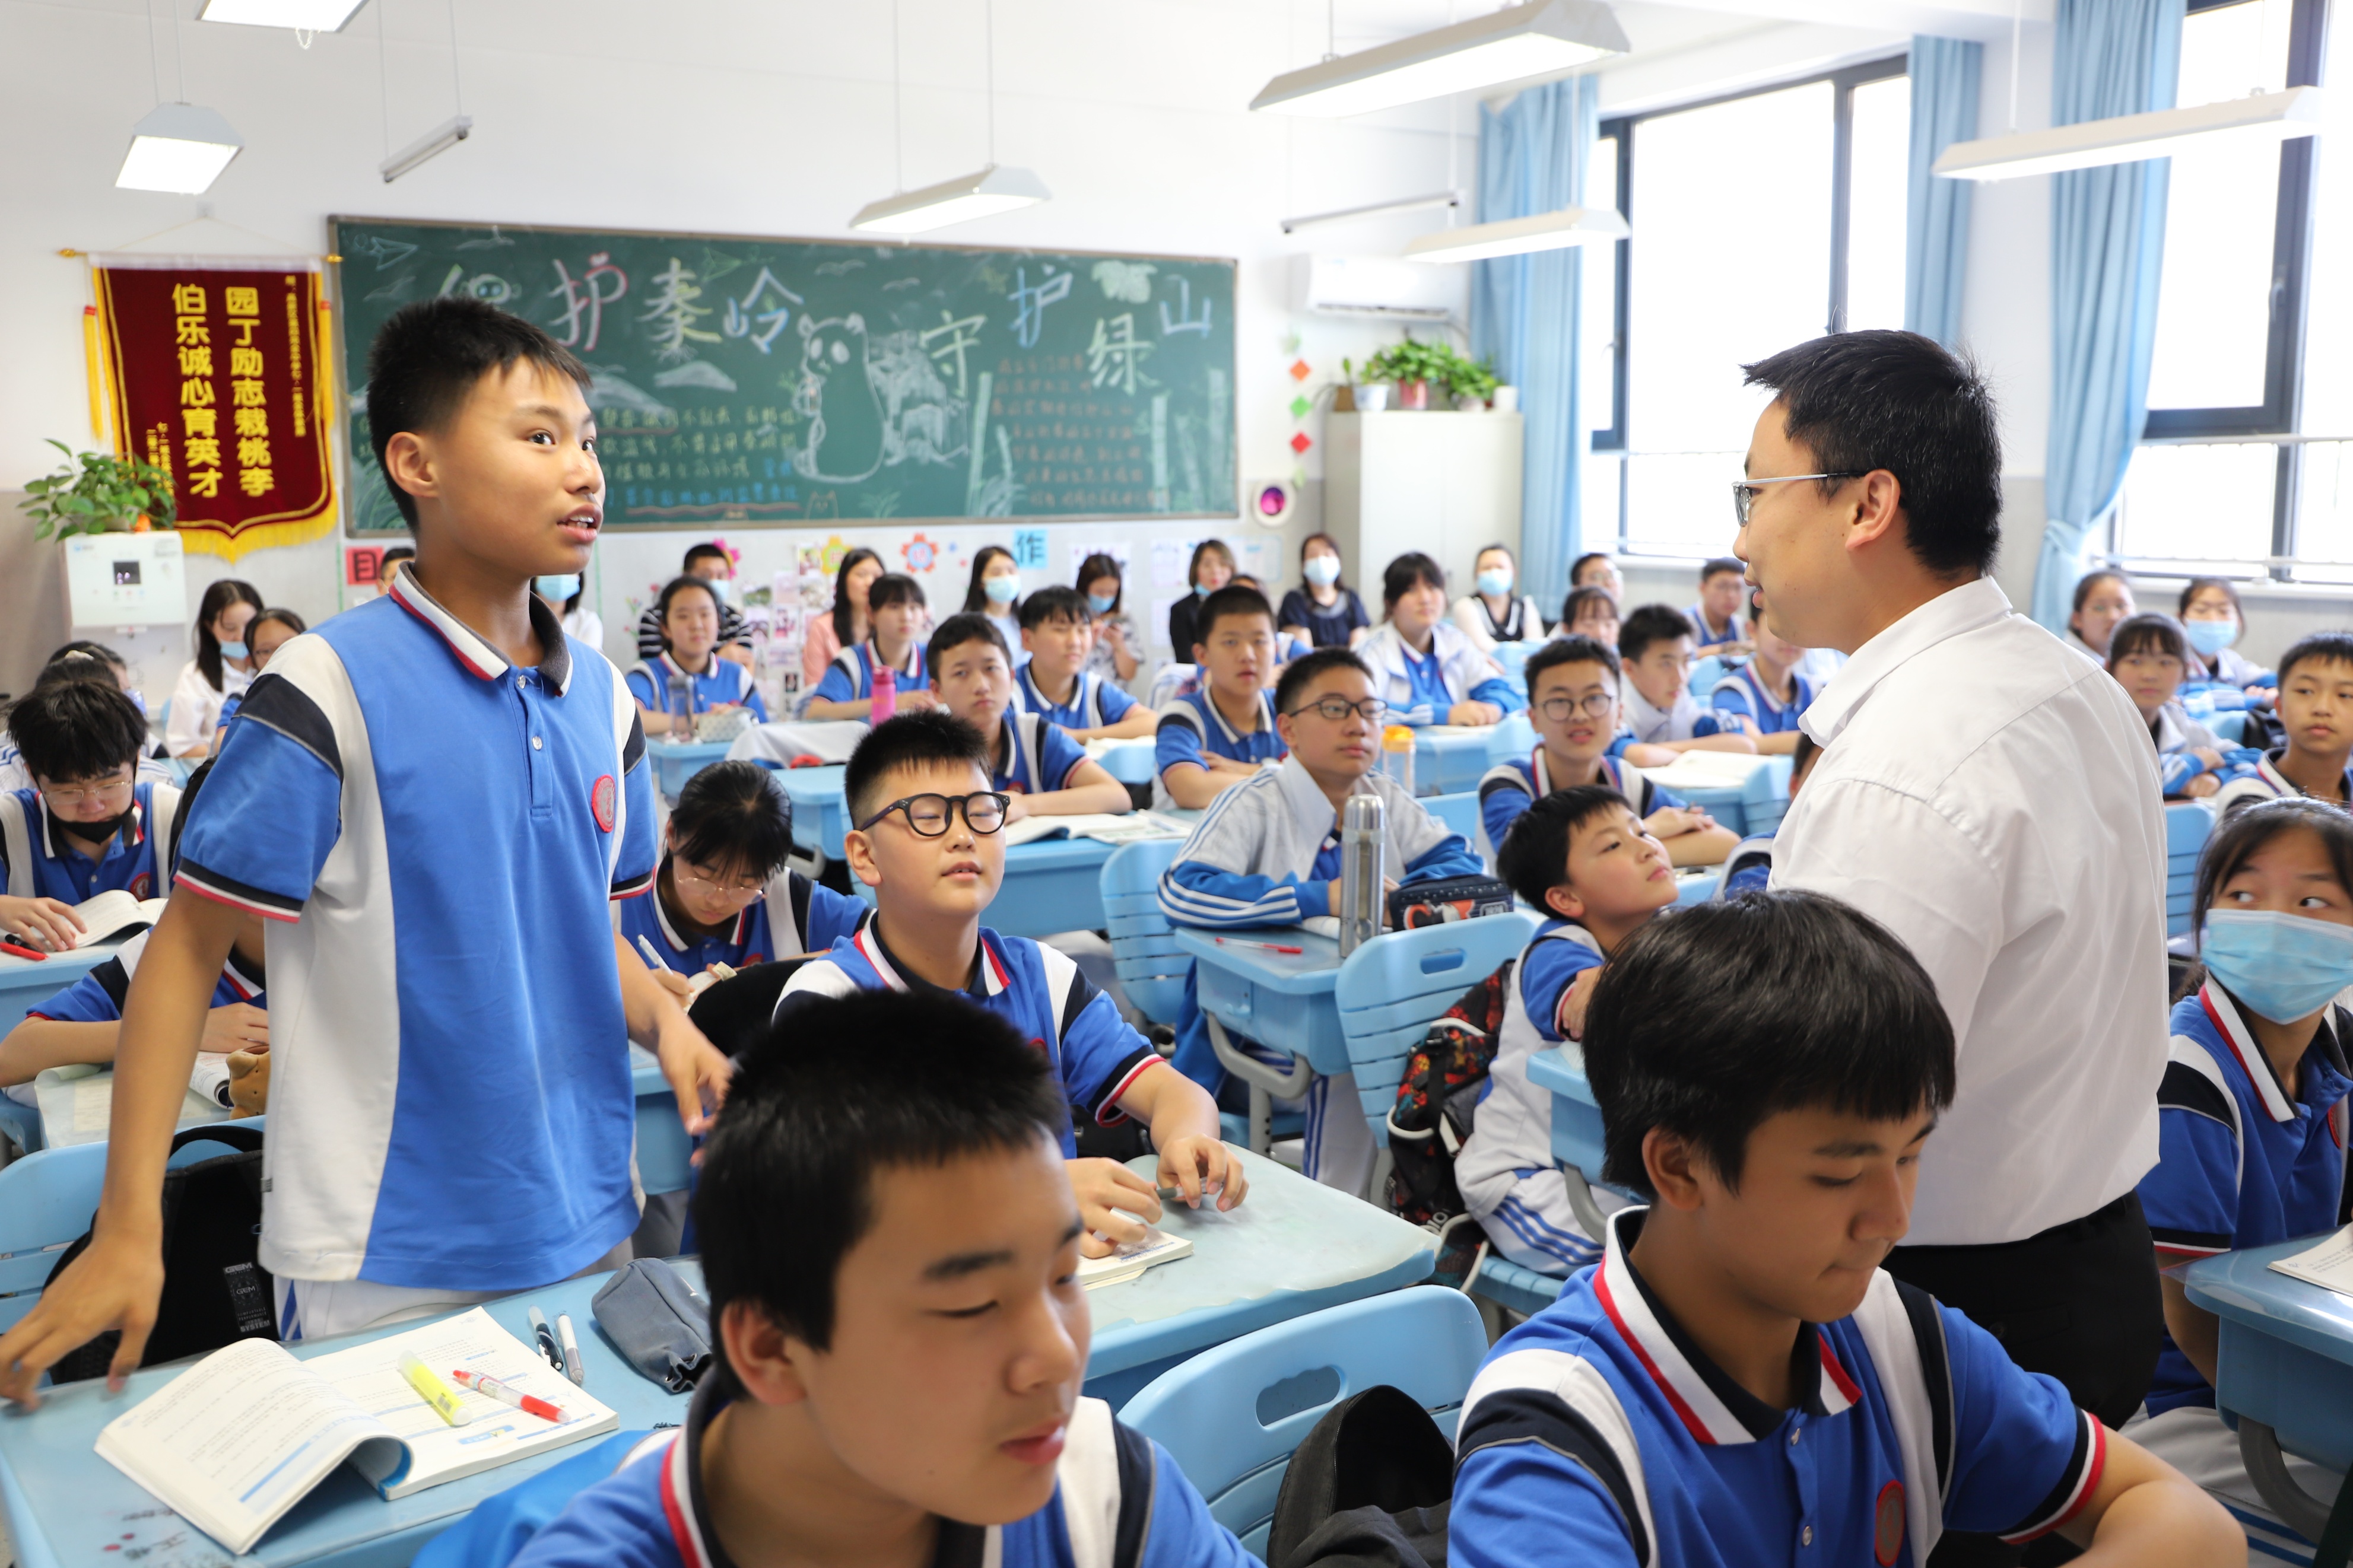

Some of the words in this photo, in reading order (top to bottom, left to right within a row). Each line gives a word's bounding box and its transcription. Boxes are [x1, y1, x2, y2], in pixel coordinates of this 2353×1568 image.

[919, 263, 1213, 399] 守护绿山
[172, 283, 223, 498] 伯乐诚心育英才
[225, 286, 275, 497] 园丁励志栽桃李
[225, 1262, 253, 1274] GEM
[236, 1285, 256, 1295] GEM
[240, 1320, 270, 1332] SYSTEM
